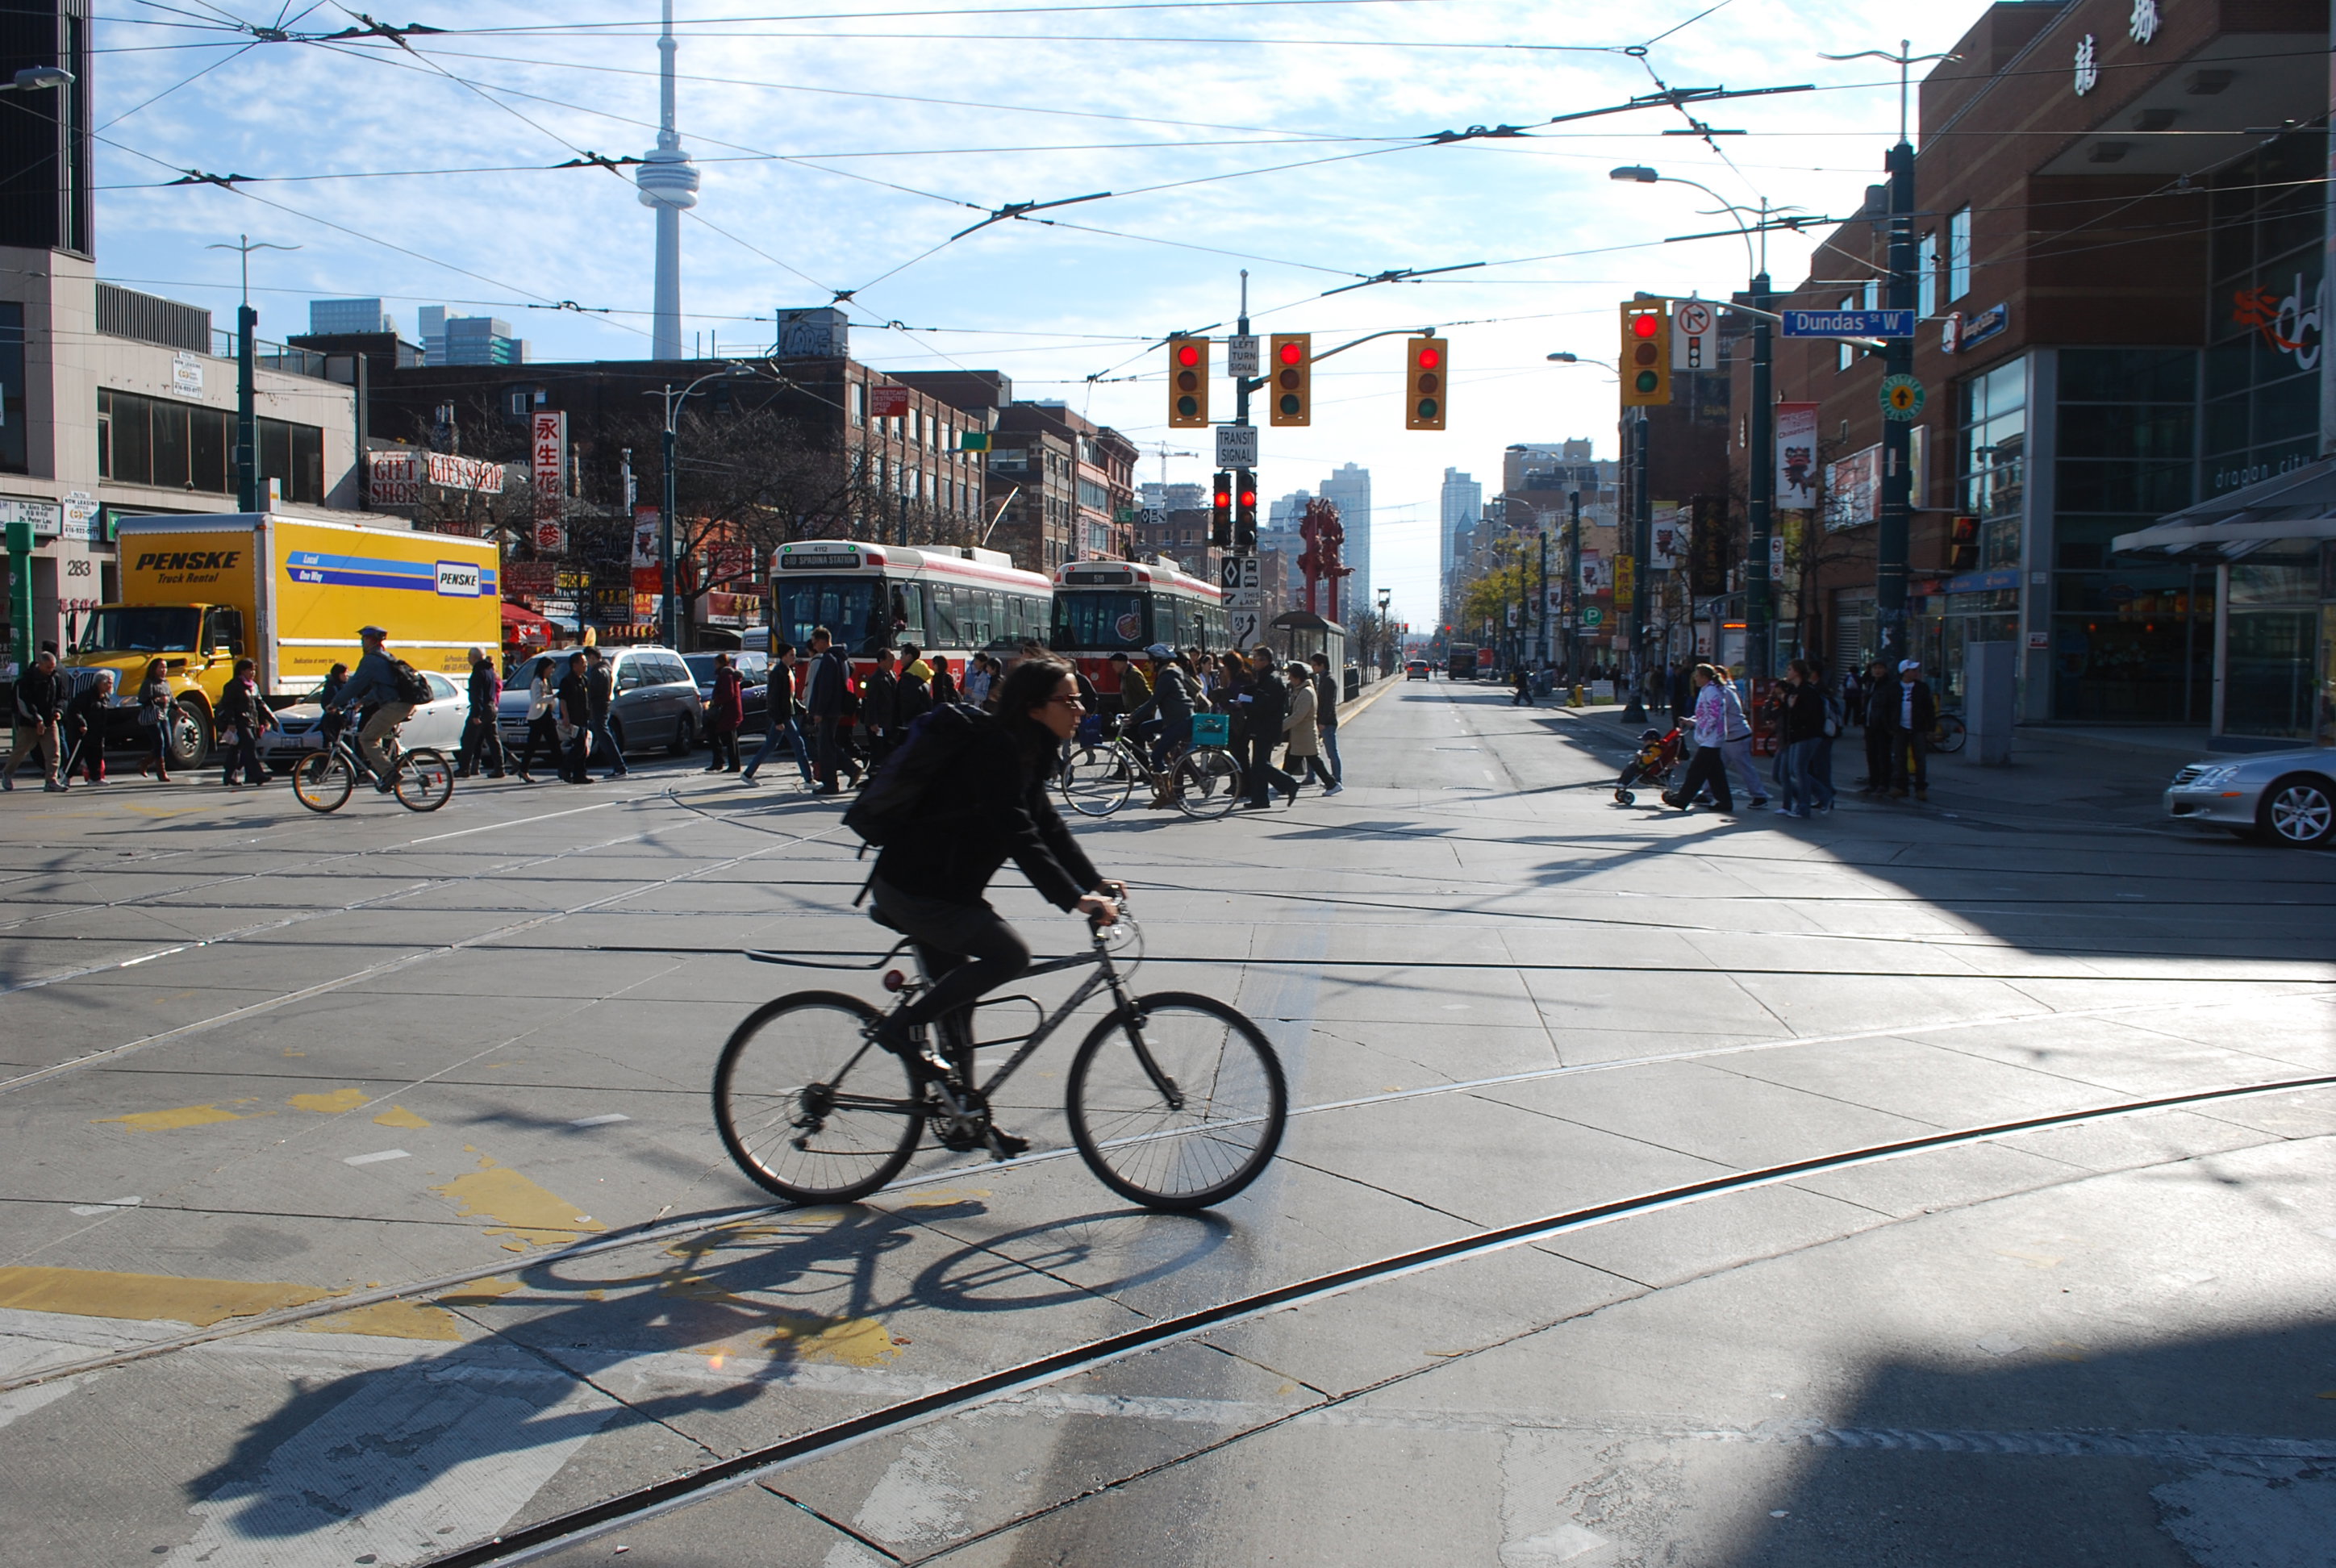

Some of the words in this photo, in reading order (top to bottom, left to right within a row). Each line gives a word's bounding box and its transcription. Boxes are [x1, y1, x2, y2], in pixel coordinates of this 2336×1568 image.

[1797, 313, 1864, 331] Dundas
[1869, 313, 1879, 323] St
[1883, 313, 1900, 330] W
[1233, 340, 1255, 349] LEFT
[1233, 352, 1257, 361] TURN
[1230, 364, 1258, 372] SIGNAL
[1219, 432, 1255, 444] TRANSIT
[1221, 448, 1253, 462] SIGNAL
[373, 459, 416, 481] GIFT
[432, 455, 463, 485] GIFT
[466, 461, 503, 490] SHOP
[2215, 463, 2269, 489] dragon
[2279, 453, 2310, 475] city
[372, 482, 420, 504] SHOP
[135, 551, 241, 571] PENSKE
[302, 553, 319, 565] Local
[784, 557, 797, 566] 510
[799, 556, 828, 565] SPADINA
[828, 555, 856, 565] STATION
[67, 560, 92, 577] 283
[157, 573, 184, 584] Truck
[186, 571, 219, 583] Rental
[299, 569, 310, 581] One
[311, 571, 323, 583] Way
[440, 572, 478, 586] PENSKE
[1094, 574, 1105, 583] 510
